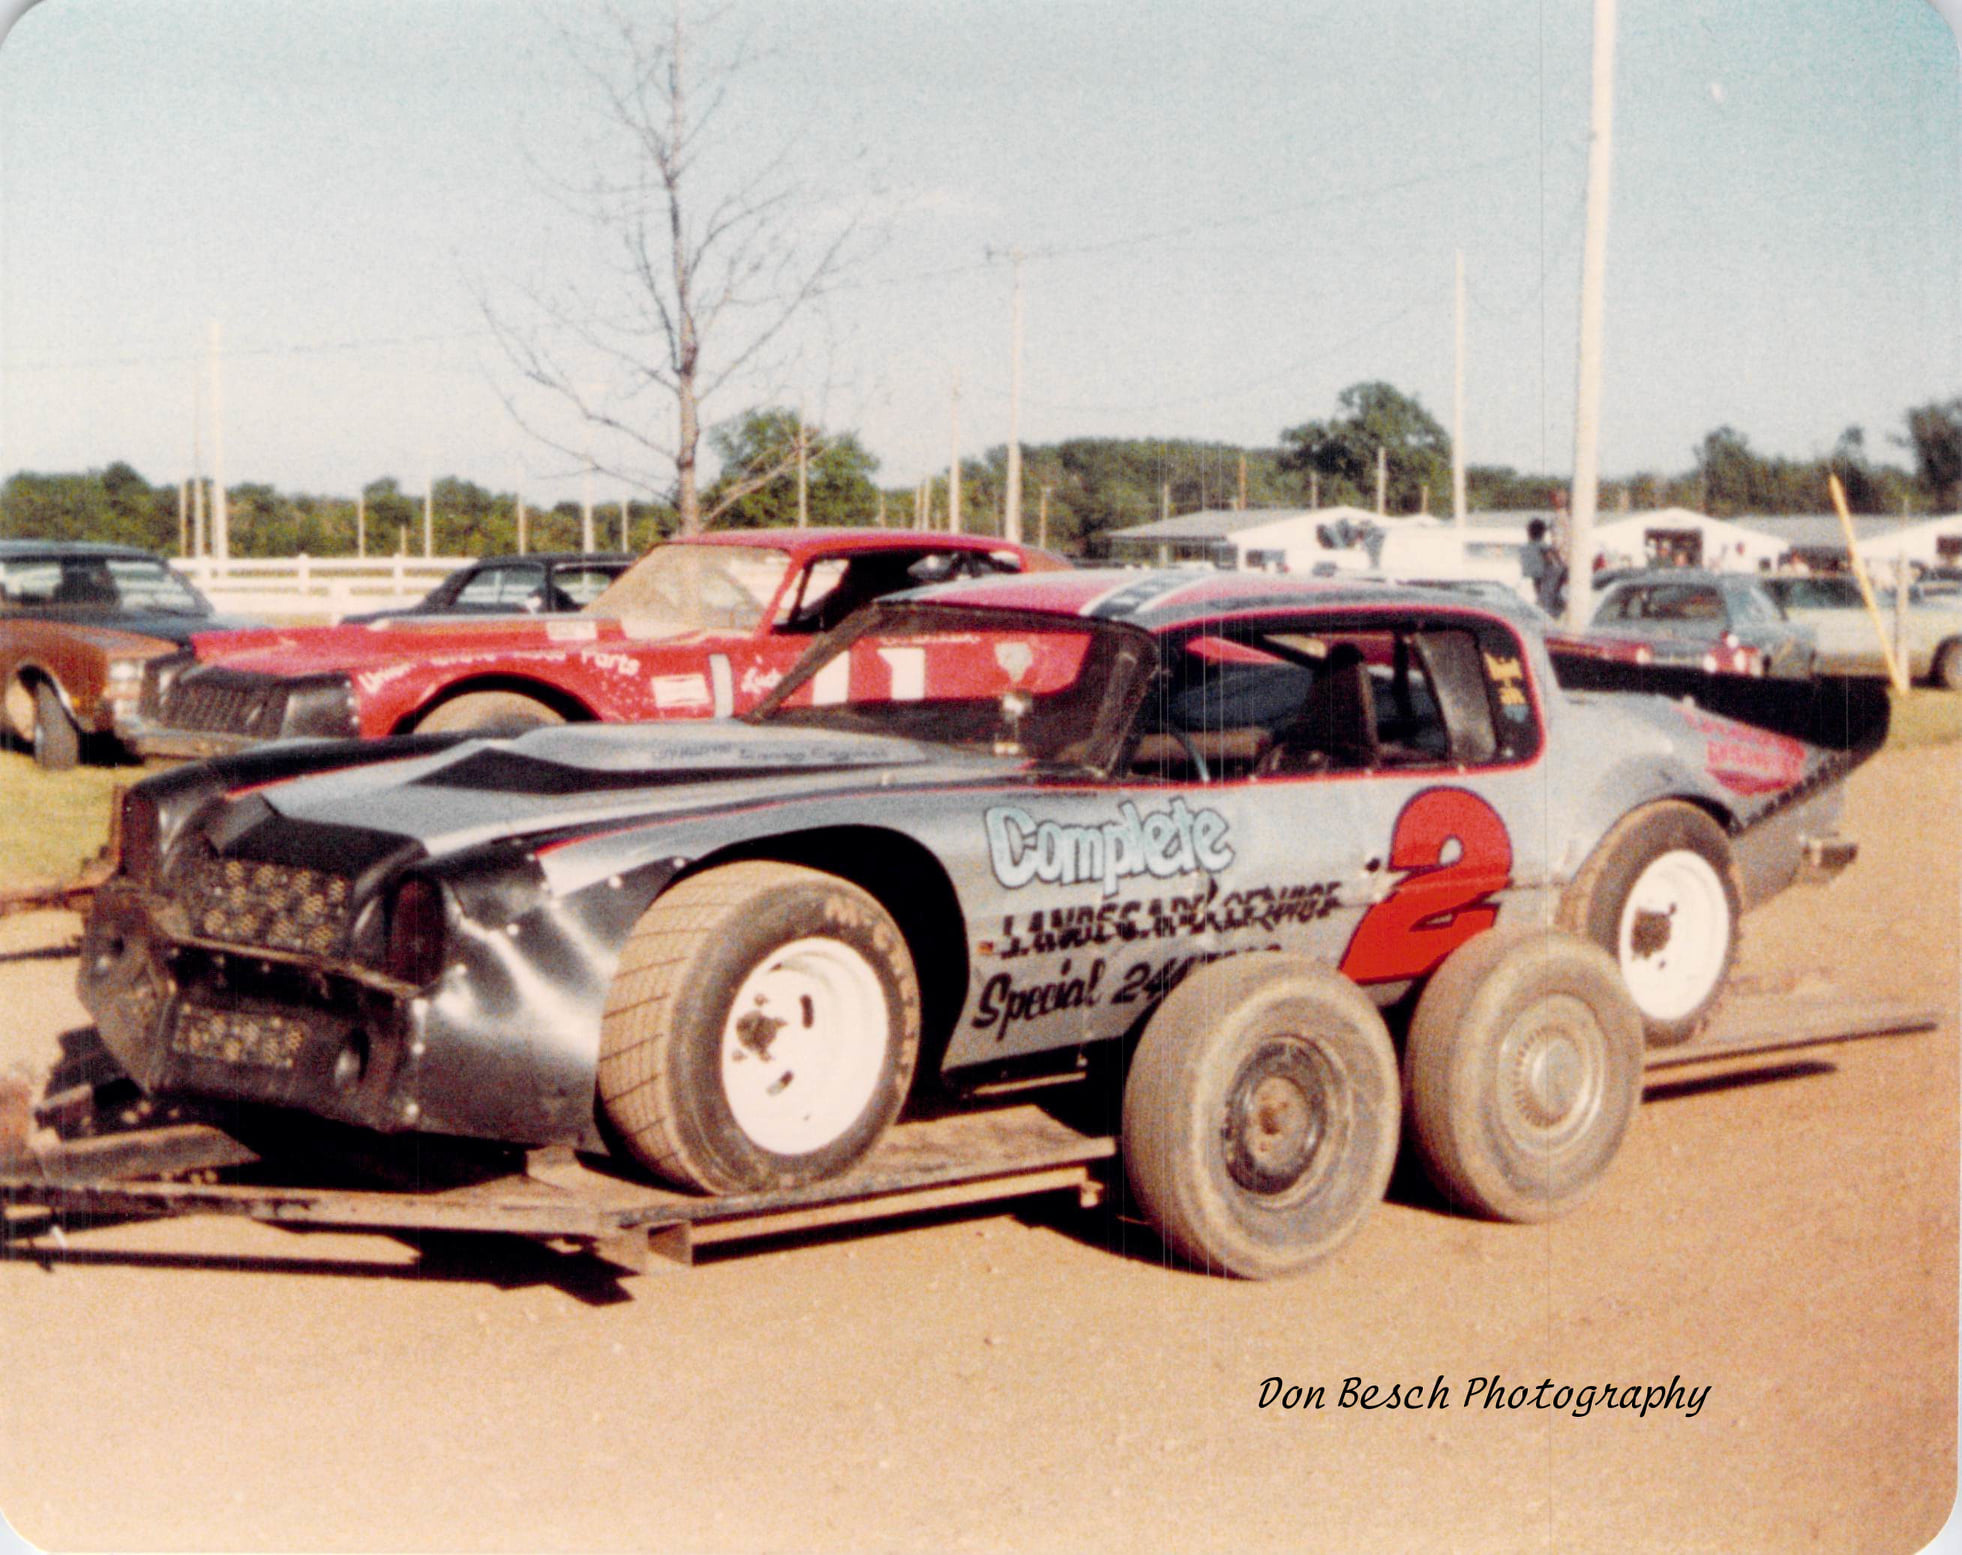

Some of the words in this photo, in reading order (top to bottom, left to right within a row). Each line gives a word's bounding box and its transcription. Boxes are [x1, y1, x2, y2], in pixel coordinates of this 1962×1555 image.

[984, 796, 1236, 898] Complete
[1337, 784, 1514, 986] 2
[972, 957, 1107, 1041] Special
